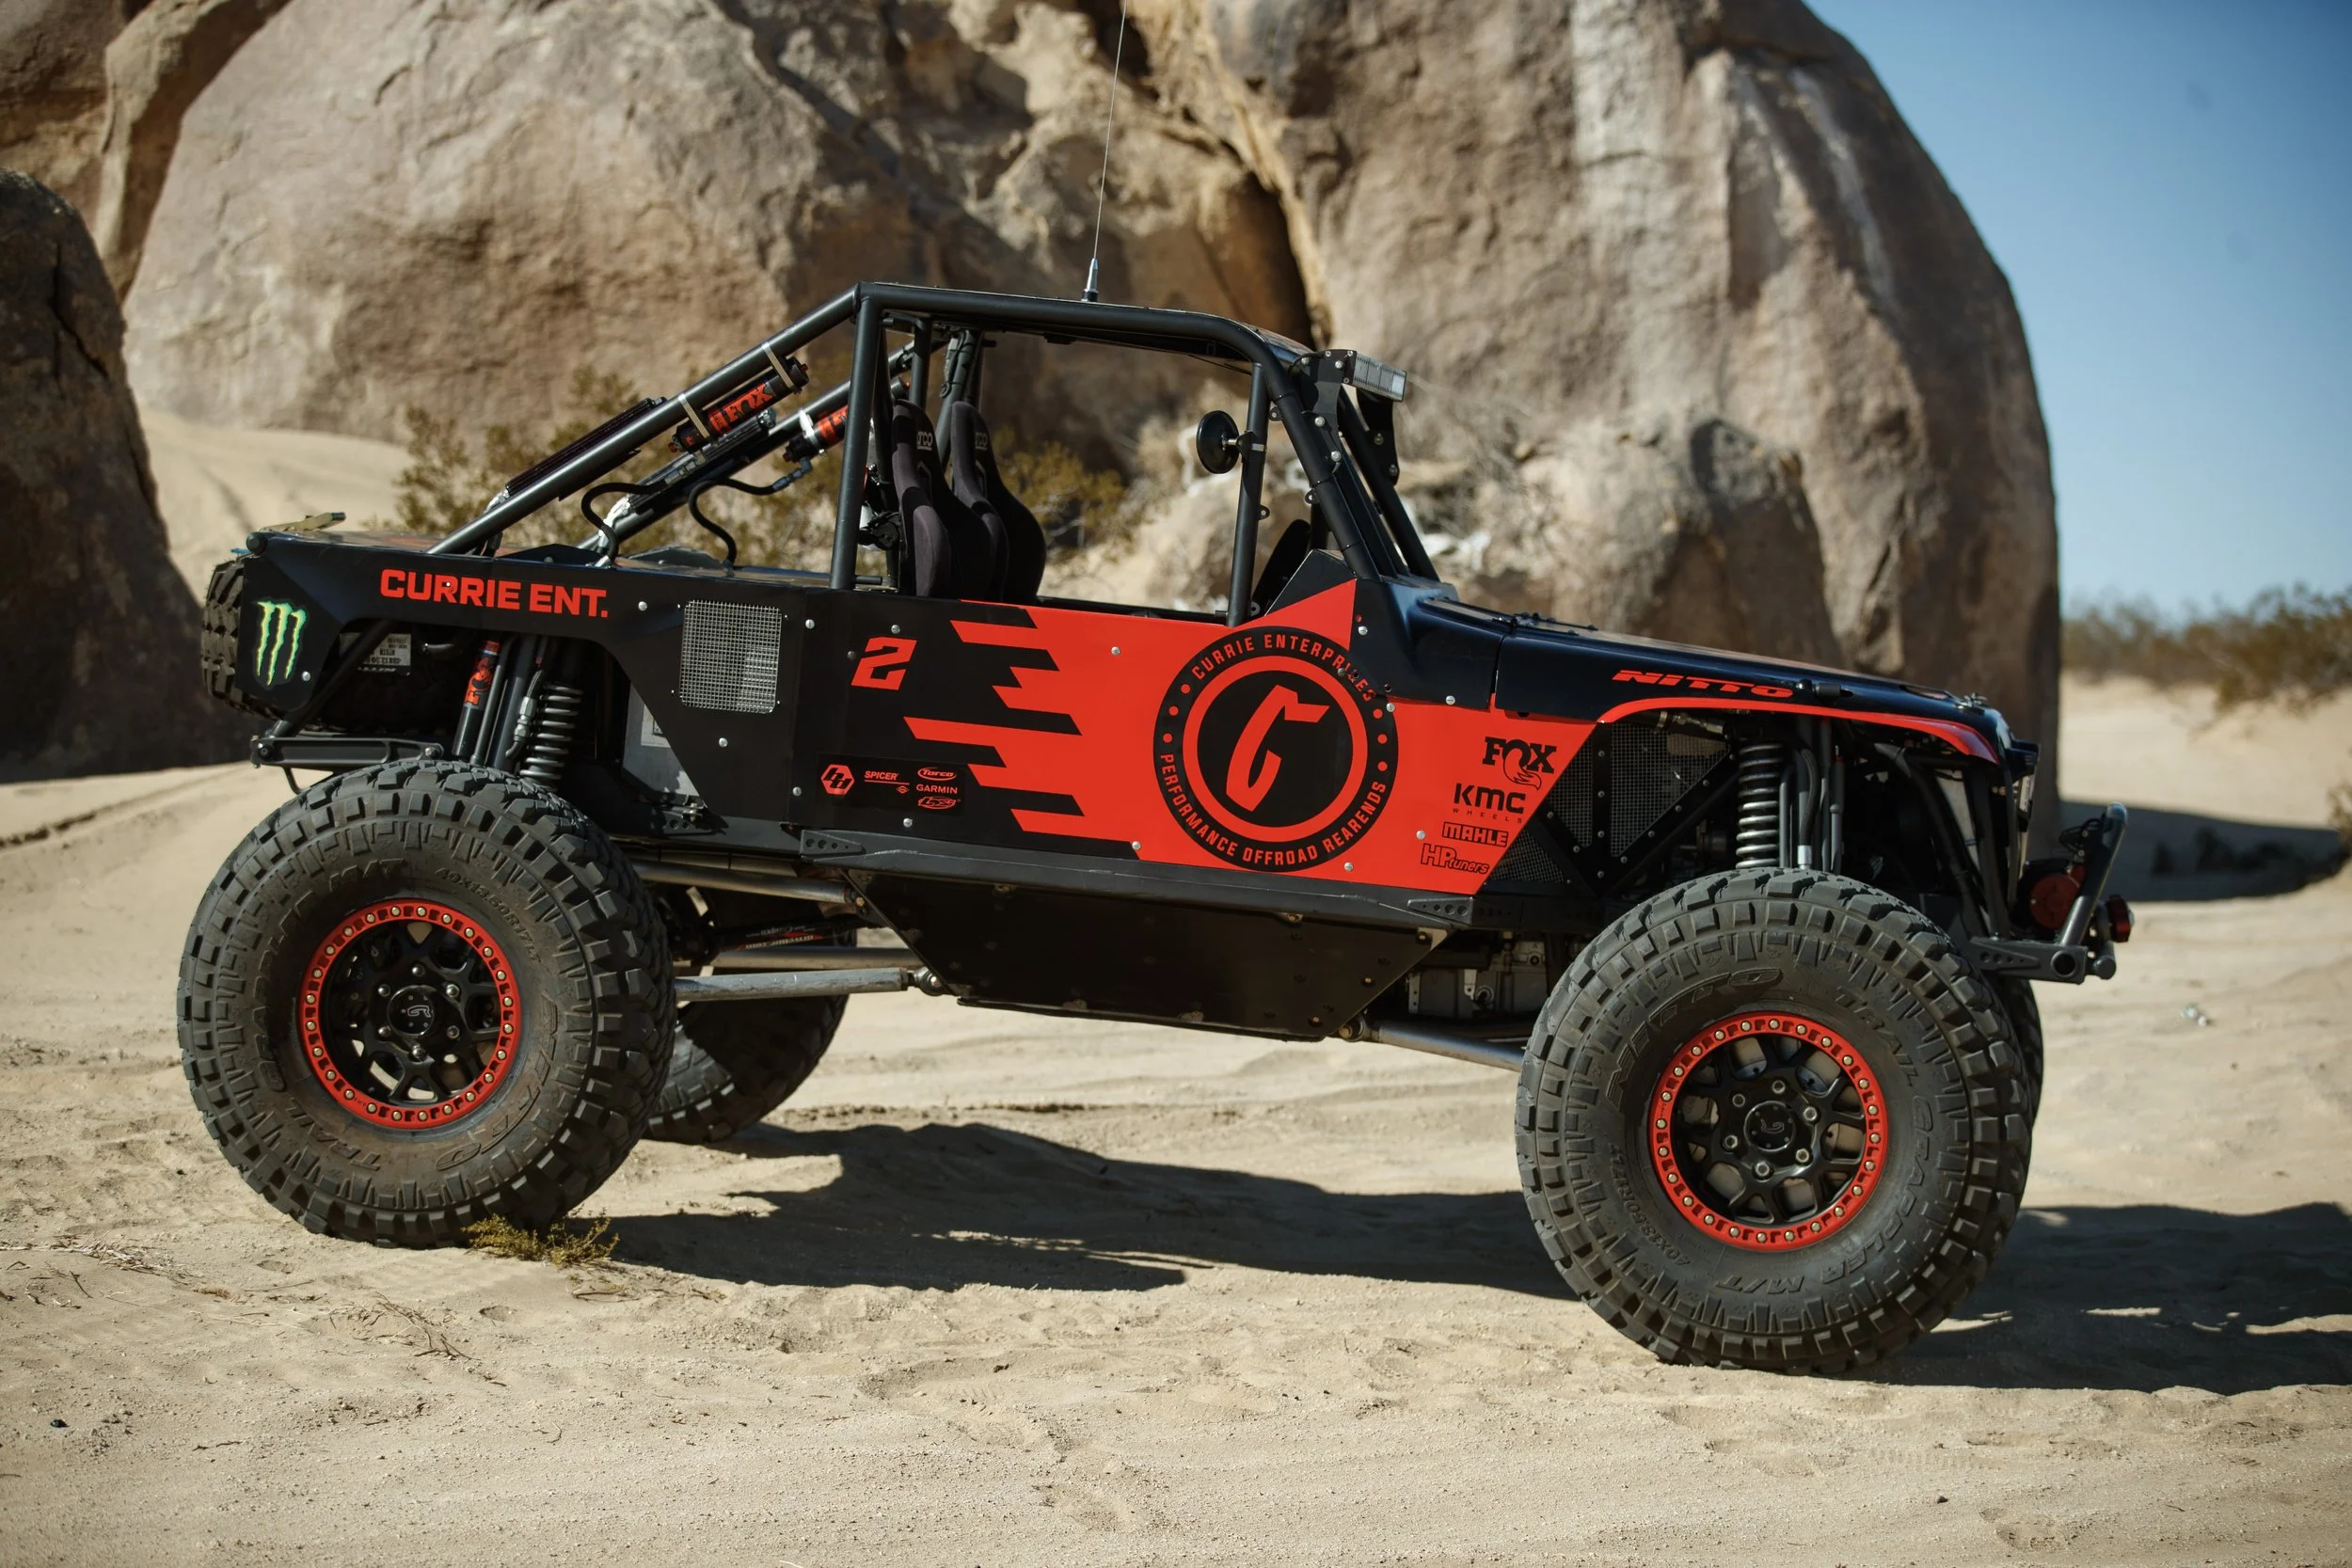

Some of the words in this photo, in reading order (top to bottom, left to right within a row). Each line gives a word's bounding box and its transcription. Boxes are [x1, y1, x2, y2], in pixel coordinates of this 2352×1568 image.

[380, 569, 521, 610] CURRIE
[529, 583, 609, 617] ENT.
[850, 636, 917, 691] 2
[1191, 634, 1254, 680] CURRIE
[1612, 669, 1794, 698] NITTO
[1482, 736, 1557, 776] FOX
[864, 770, 898, 781] SPICER
[915, 784, 959, 795] GARMIN
[1160, 753, 1238, 857] PERFORMANCE
[1242, 845, 1318, 866] OFFROAD
[1325, 781, 1386, 853] REARENDS
[1453, 807, 1523, 824] WHEELS
[1454, 783, 1526, 815] KMC
[1442, 821, 1509, 847] MAHLE
[1606, 966, 1784, 1109] NITTO
